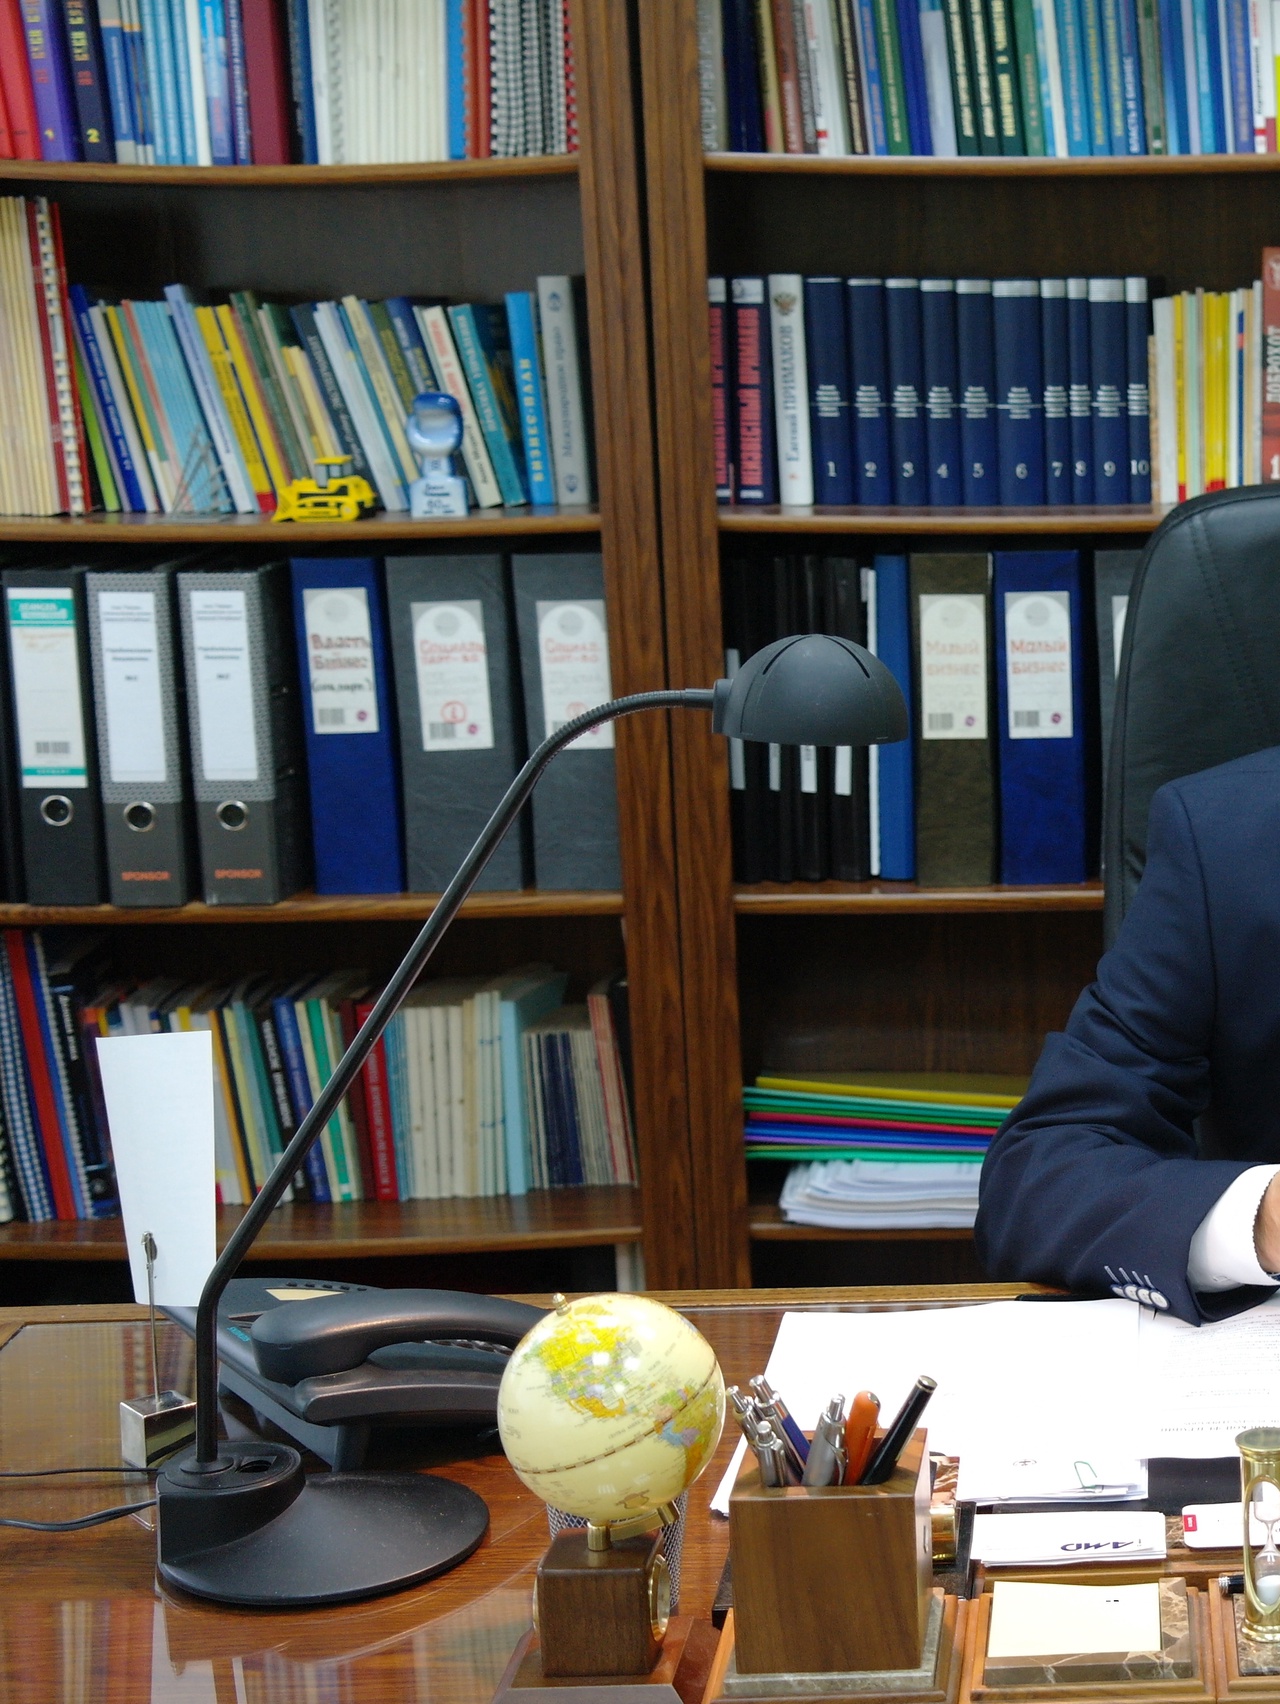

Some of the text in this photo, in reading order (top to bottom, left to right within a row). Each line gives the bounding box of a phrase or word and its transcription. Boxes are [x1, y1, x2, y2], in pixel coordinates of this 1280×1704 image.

[1123, 55, 1136, 99] БИЗНЕС
[87, 128, 100, 143] 2
[1127, 110, 1140, 154] ВЛАСТЬ
[780, 325, 796, 411] ПРИМАКОВ
[518, 358, 545, 483] БИЗНЕС-ПЛАН
[826, 461, 837, 478] 1
[864, 461, 877, 478] 2
[902, 461, 915, 478] 3
[936, 463, 949, 479] 4
[972, 462, 984, 479] 5
[1015, 463, 1028, 480] 6
[1052, 461, 1063, 478] 7
[1075, 460, 1087, 477] 8
[1103, 461, 1116, 478] 9
[1130, 459, 1149, 476] 10
[121, 870, 170, 881] SPONSOR
[214, 868, 263, 879] SPONSOR
